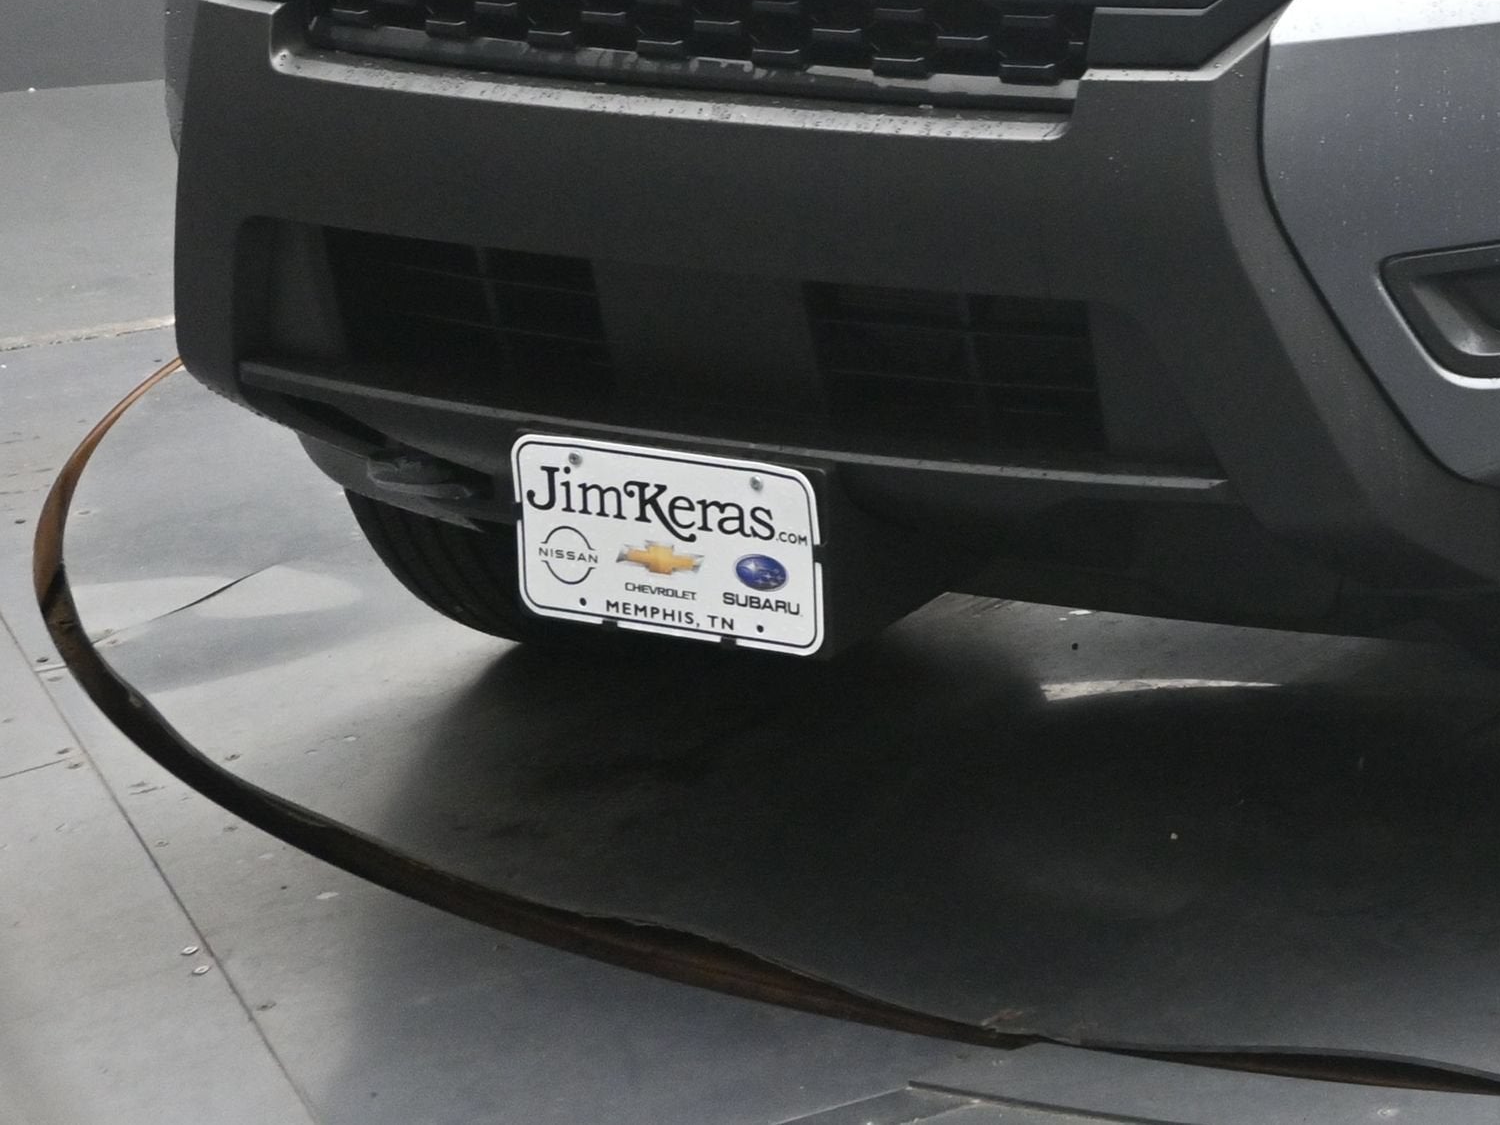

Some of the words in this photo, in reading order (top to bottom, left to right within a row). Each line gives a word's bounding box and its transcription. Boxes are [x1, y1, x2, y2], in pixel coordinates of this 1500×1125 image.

[538, 546, 599, 564] NISSAN
[624, 581, 697, 601] CHEVROLET
[722, 591, 801, 616] SUBARU
[606, 599, 700, 628] MEMPHIS,
[707, 614, 735, 631] TN
